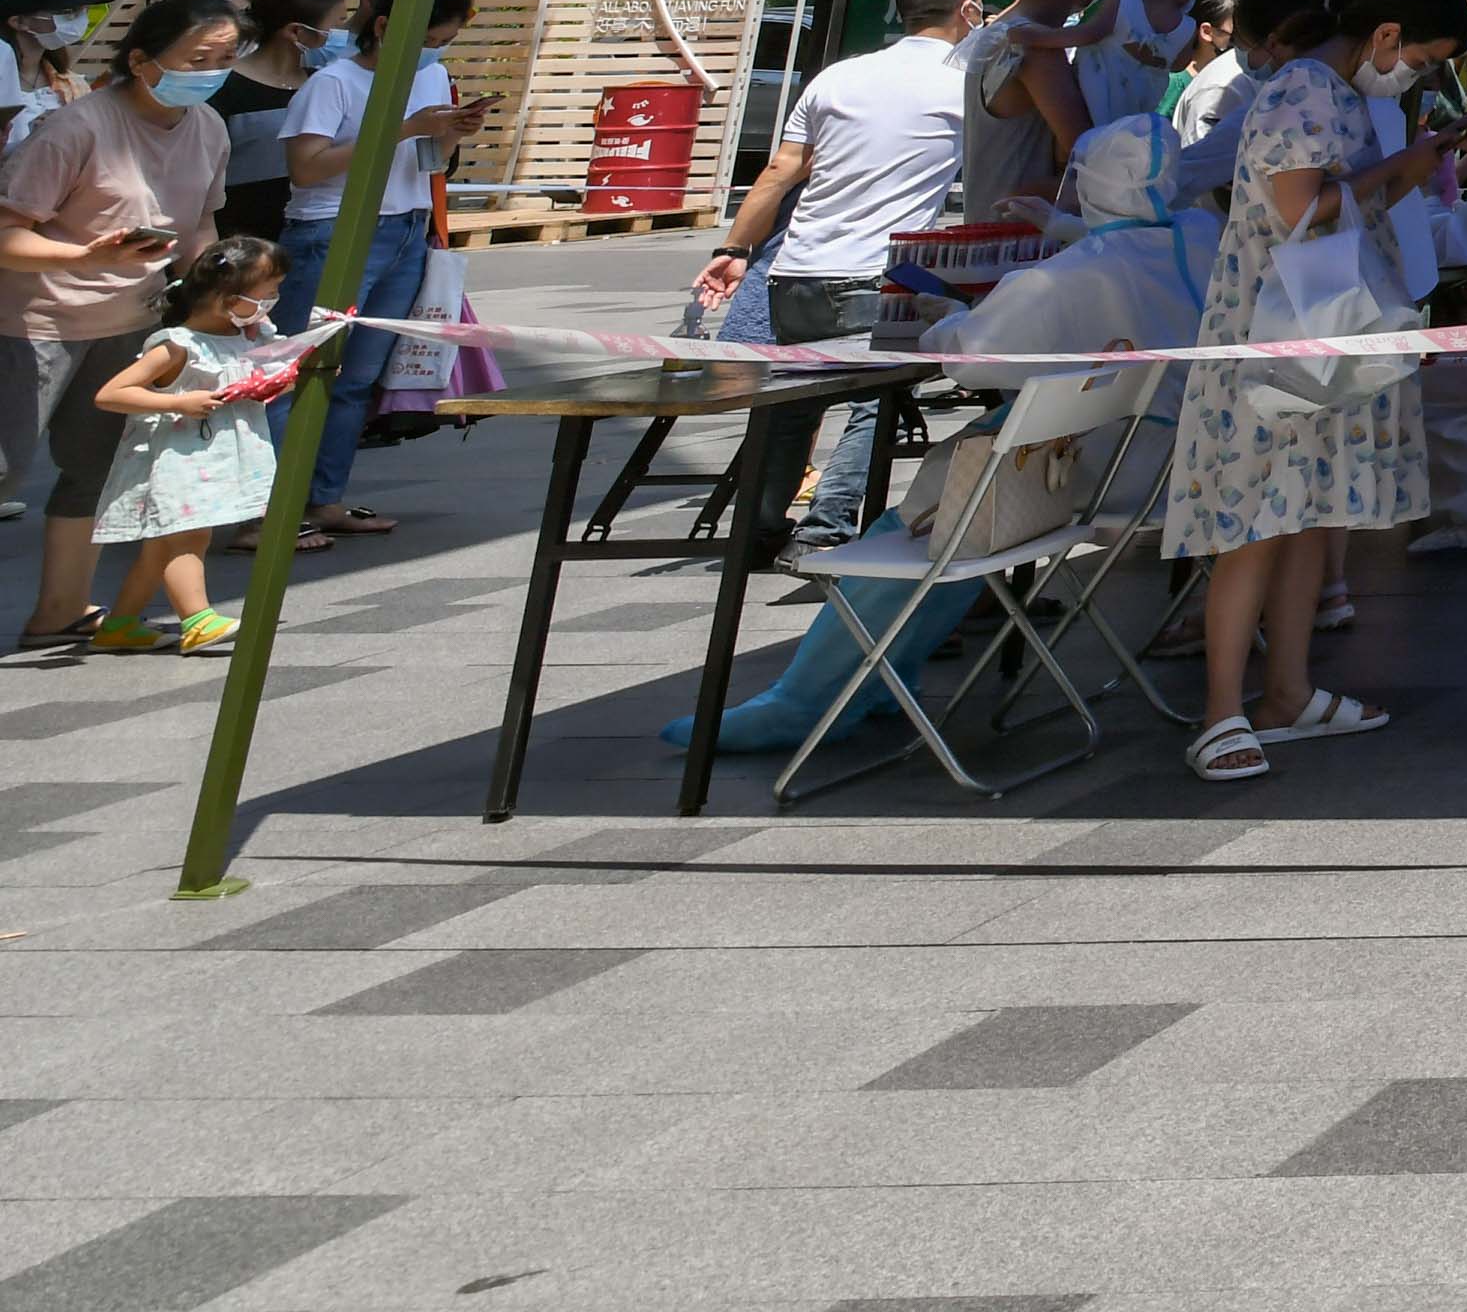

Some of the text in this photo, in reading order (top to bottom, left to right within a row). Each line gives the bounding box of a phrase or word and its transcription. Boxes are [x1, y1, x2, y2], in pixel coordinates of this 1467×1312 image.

[600, 1, 619, 13] ALL
[624, 1, 653, 13] ABO
[719, 0, 746, 13] FUN
